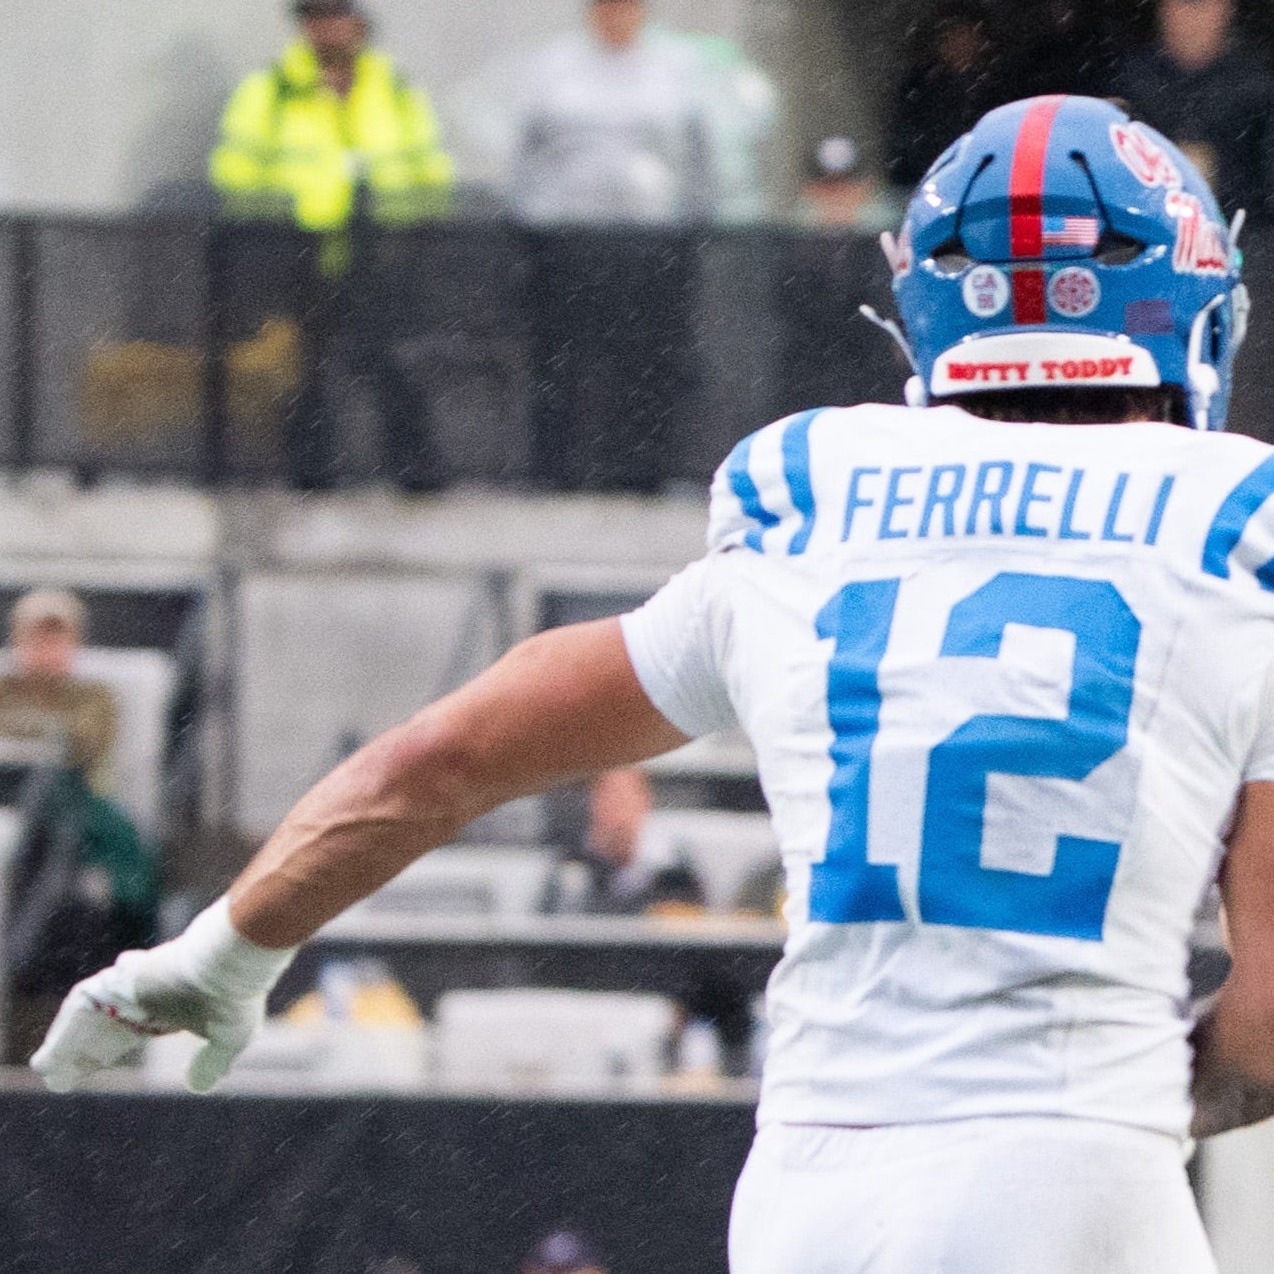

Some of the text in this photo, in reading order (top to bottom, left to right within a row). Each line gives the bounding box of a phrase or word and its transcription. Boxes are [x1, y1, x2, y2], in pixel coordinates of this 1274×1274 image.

[1040, 356, 1133, 381] TODDY
[841, 460, 1175, 546] FERRELLI
[808, 571, 1143, 943] 12
